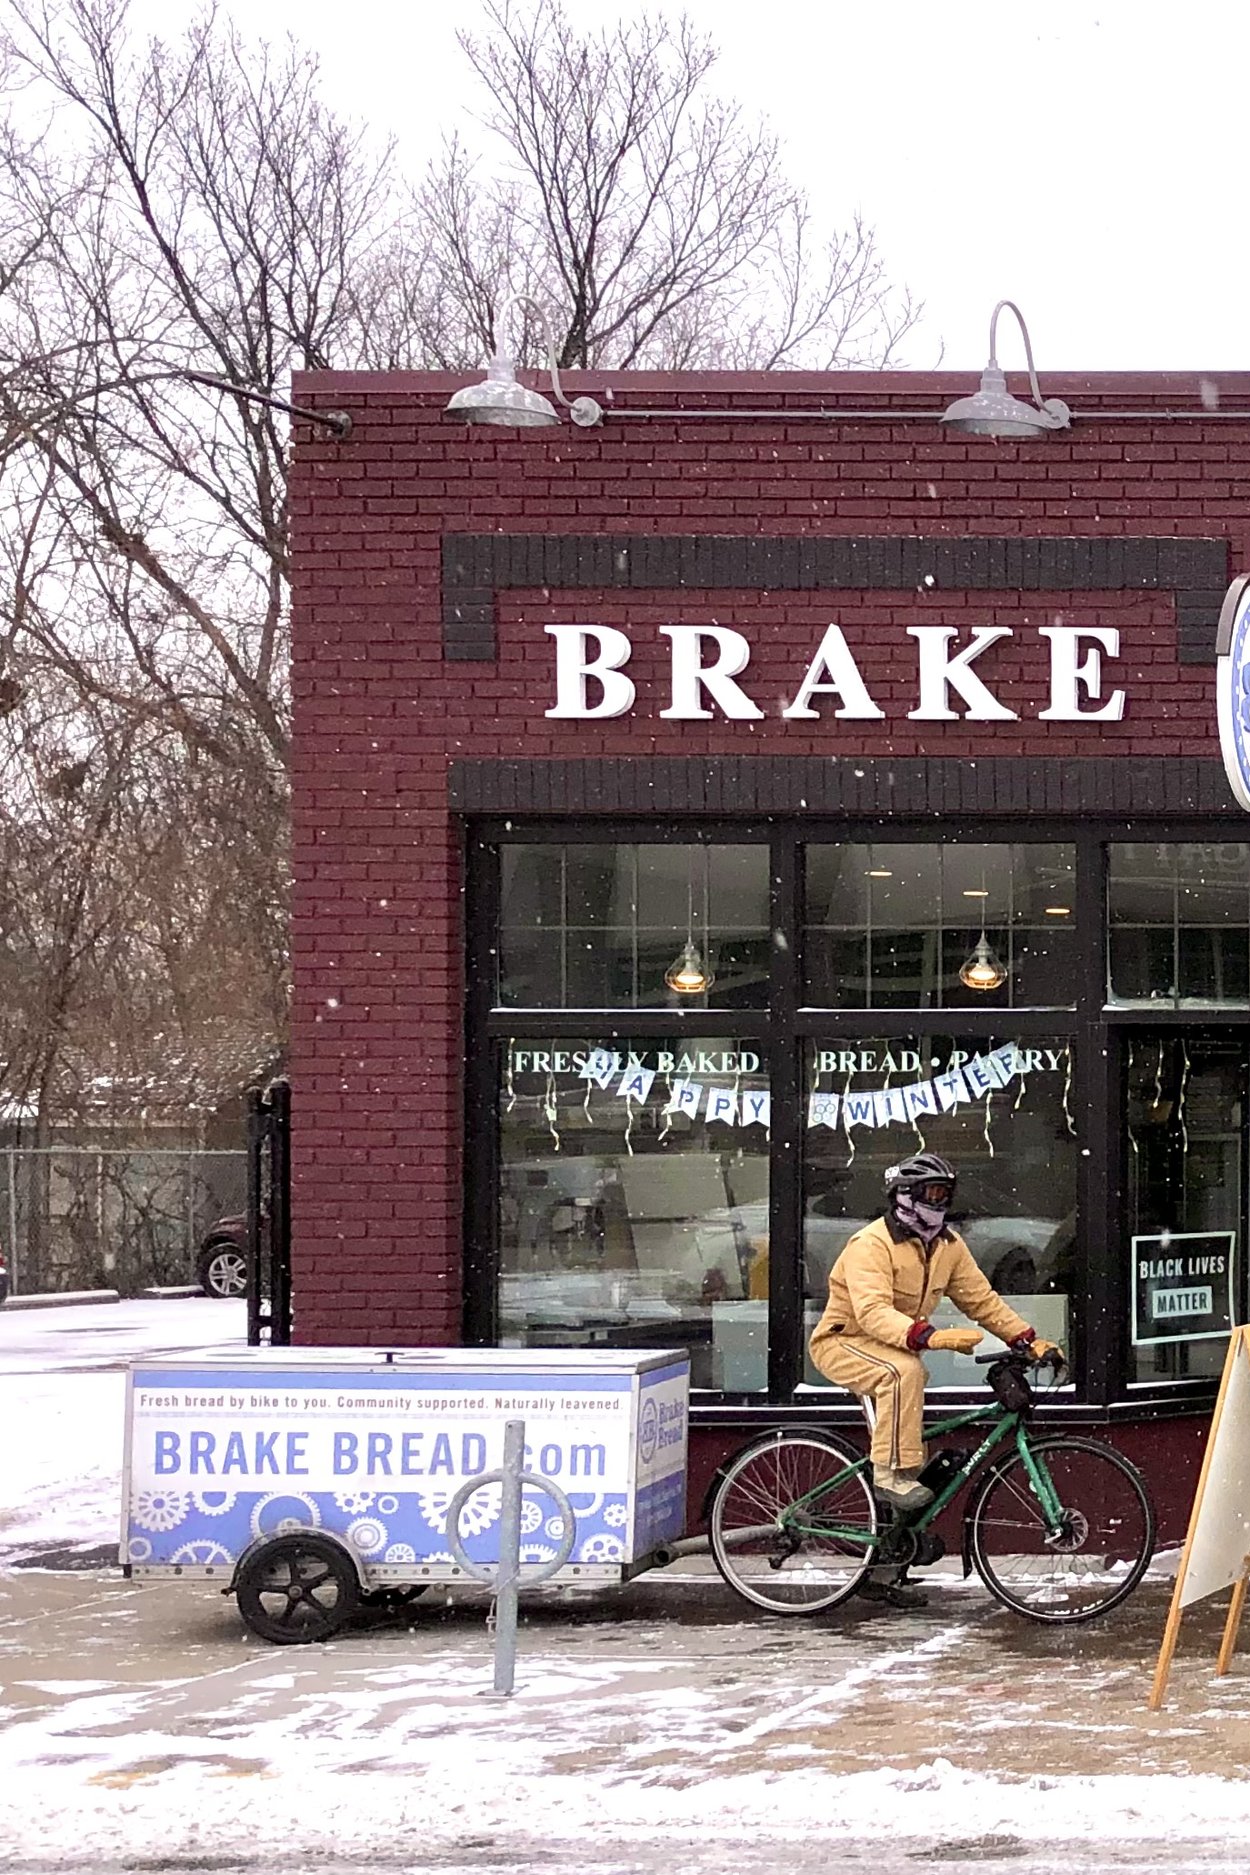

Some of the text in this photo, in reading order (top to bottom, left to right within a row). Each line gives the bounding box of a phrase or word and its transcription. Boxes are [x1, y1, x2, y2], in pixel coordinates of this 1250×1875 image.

[543, 623, 1124, 720] BRAKE
[657, 1051, 760, 1073] BAKED
[820, 1049, 1064, 1073] BREAD PARY
[1139, 1255, 1226, 1279] BLACK LIVES
[1157, 1292, 1208, 1313] MATTER
[140, 1394, 624, 1411] Fresh bread by bike to you. Community supported. Naturally leavened.
[154, 1431, 309, 1475] BRAKE
[332, 1432, 487, 1476] BREAD
[961, 1438, 991, 1476] SURLY
